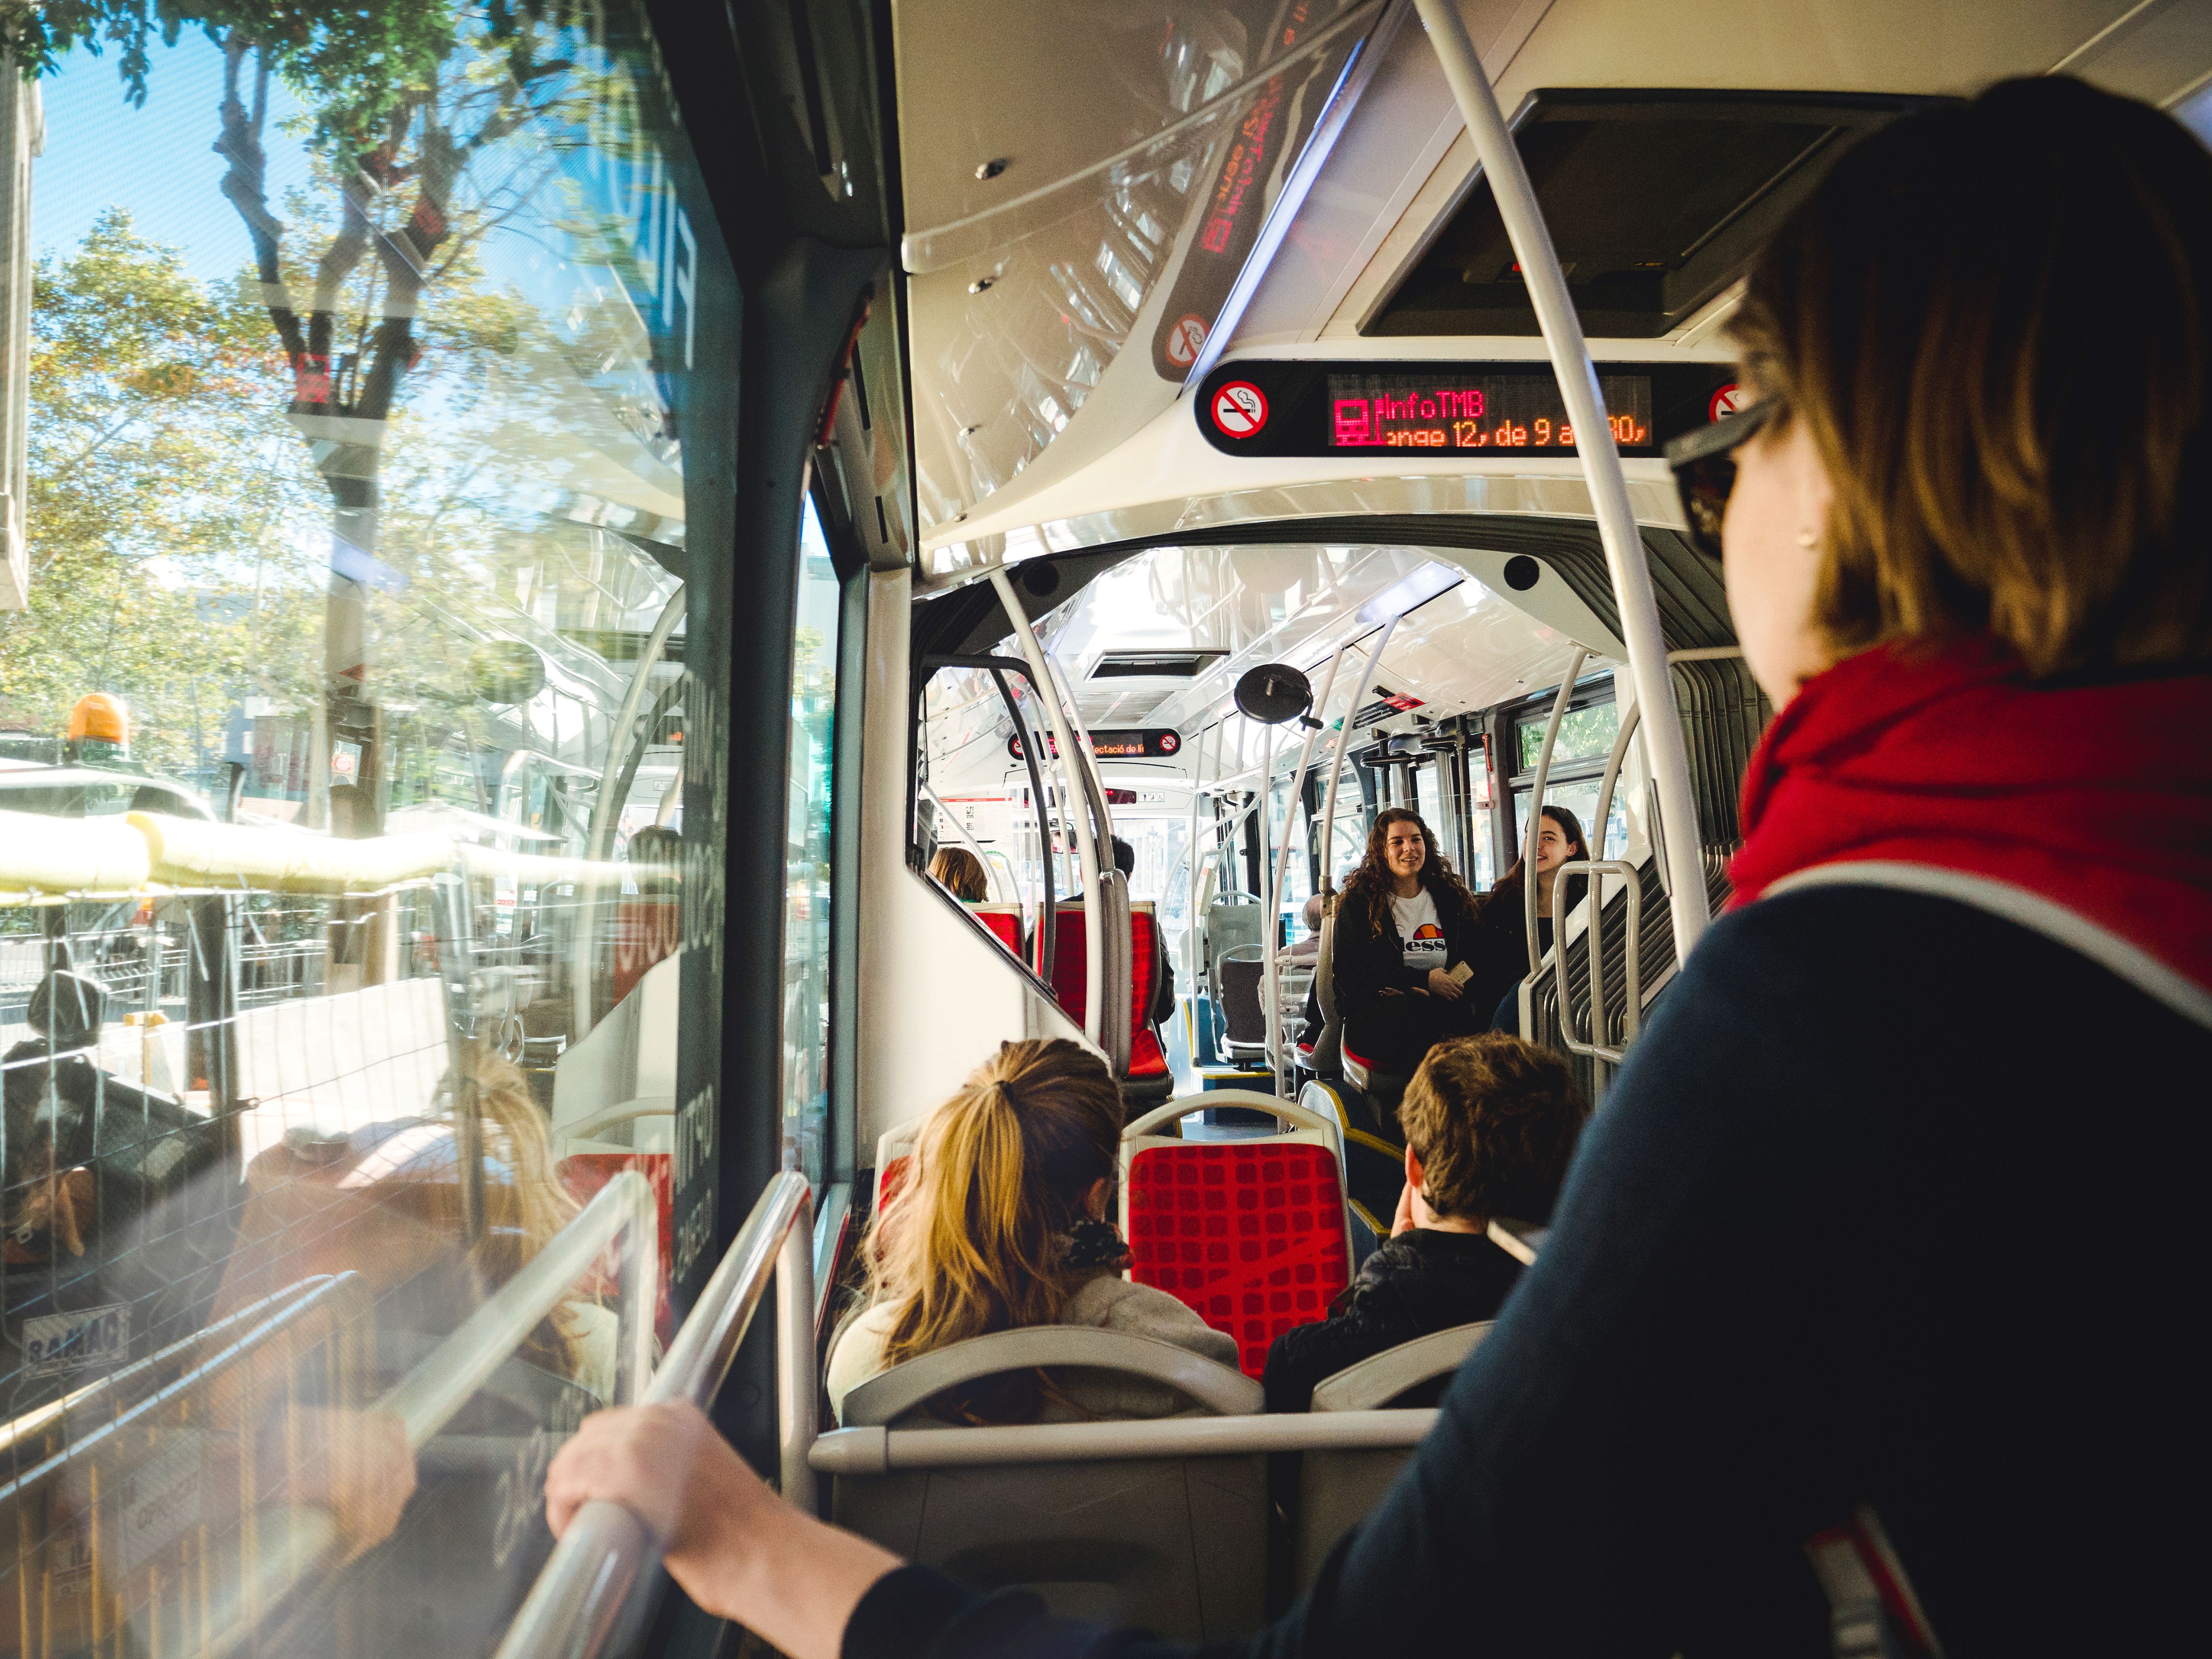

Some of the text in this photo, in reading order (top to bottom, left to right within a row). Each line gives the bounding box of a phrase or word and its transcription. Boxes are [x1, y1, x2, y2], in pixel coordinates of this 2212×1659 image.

[1385, 390, 1484, 419] InfoTMB
[1453, 420, 1488, 447] 12,
[1495, 419, 1527, 446] de
[1534, 418, 1550, 445] 9
[1126, 744, 1136, 754] de
